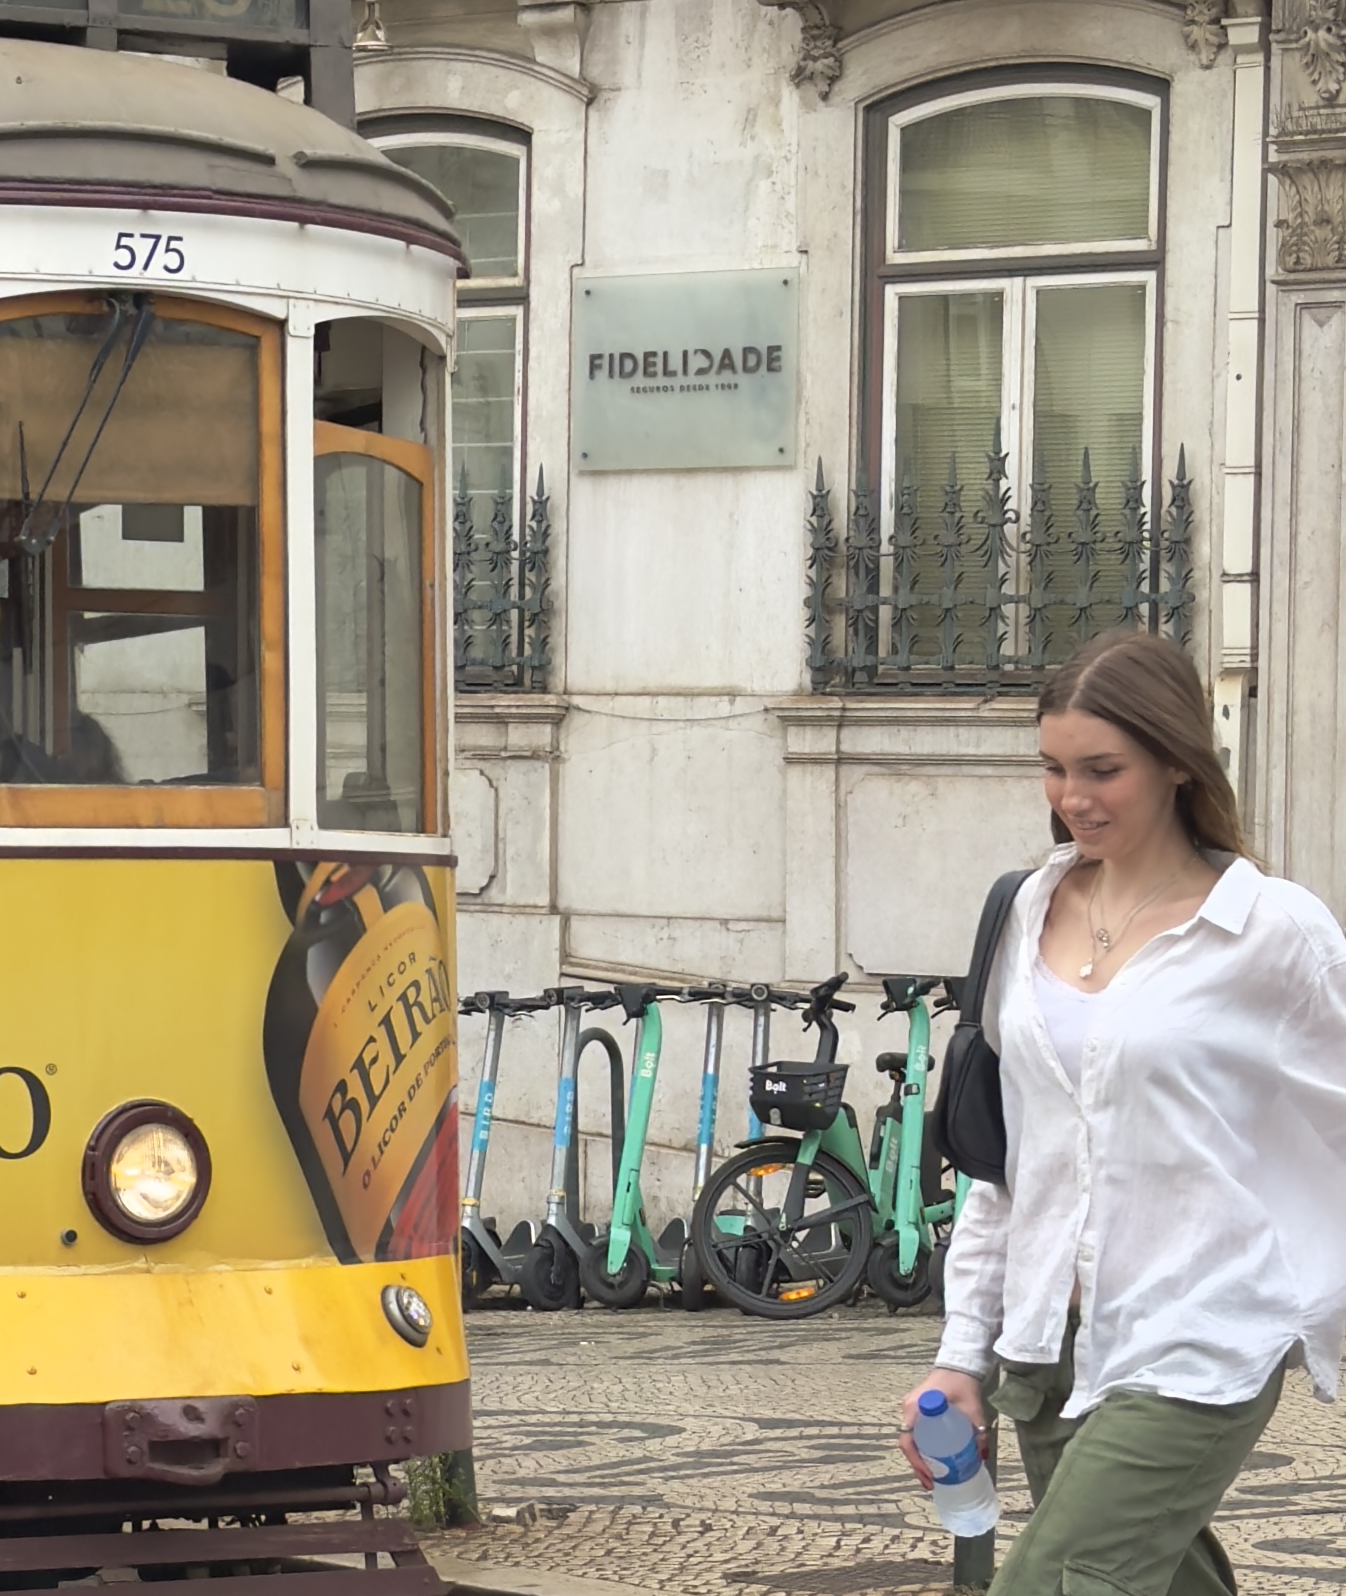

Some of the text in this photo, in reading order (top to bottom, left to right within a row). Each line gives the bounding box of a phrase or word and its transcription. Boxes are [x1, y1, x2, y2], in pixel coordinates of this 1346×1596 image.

[113, 232, 185, 274] 575
[589, 345, 782, 380] FIDELIDADE
[367, 952, 416, 1013] LICOR
[322, 956, 451, 1176] BEIRÃO
[640, 1052, 656, 1077] Bolt
[765, 1079, 787, 1093] Bolt
[371, 1101, 407, 1171] LICOR
[408, 1072, 423, 1103] DE
[479, 1092, 493, 1140] BIRD
